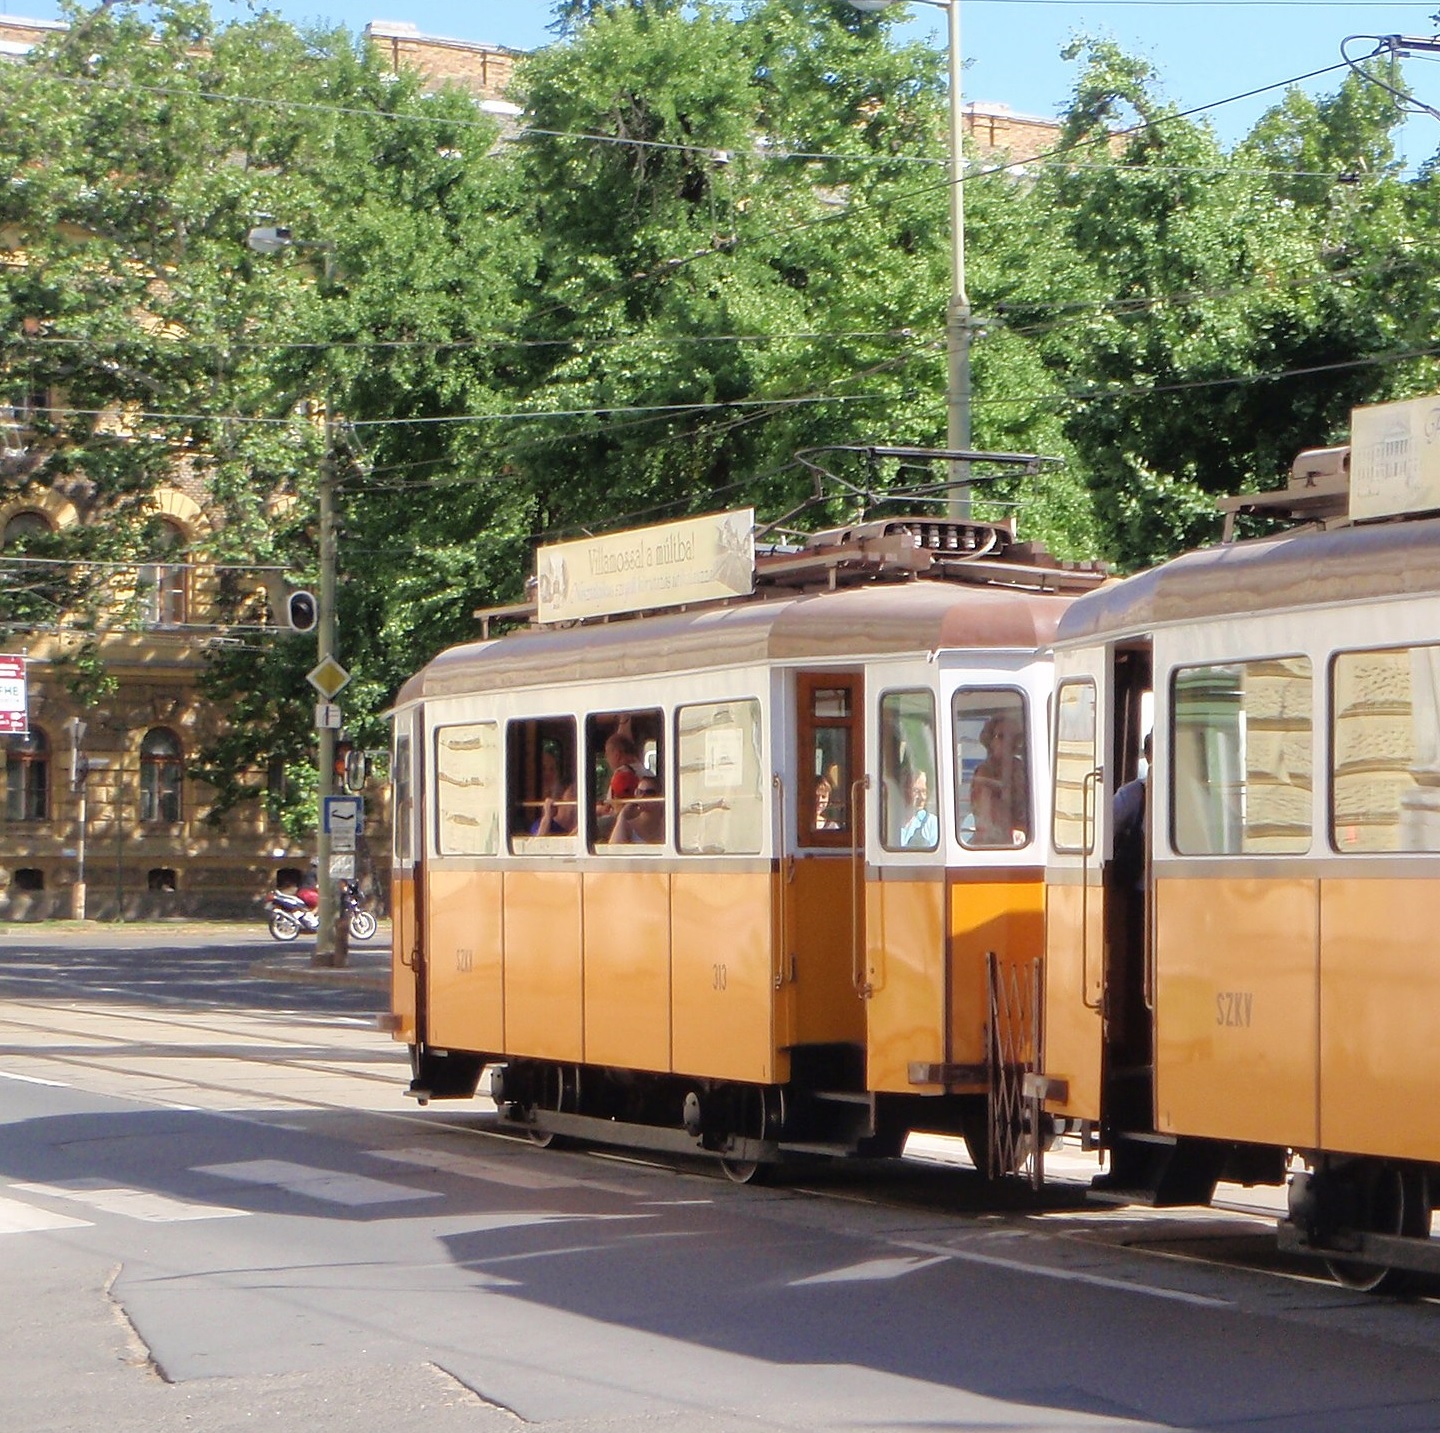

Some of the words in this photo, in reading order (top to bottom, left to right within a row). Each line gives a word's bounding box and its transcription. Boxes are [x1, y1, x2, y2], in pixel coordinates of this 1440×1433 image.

[588, 540, 643, 575] Villamossal
[647, 547, 653, 567] a
[712, 963, 727, 991] 313
[1216, 991, 1253, 1029] SZKV
